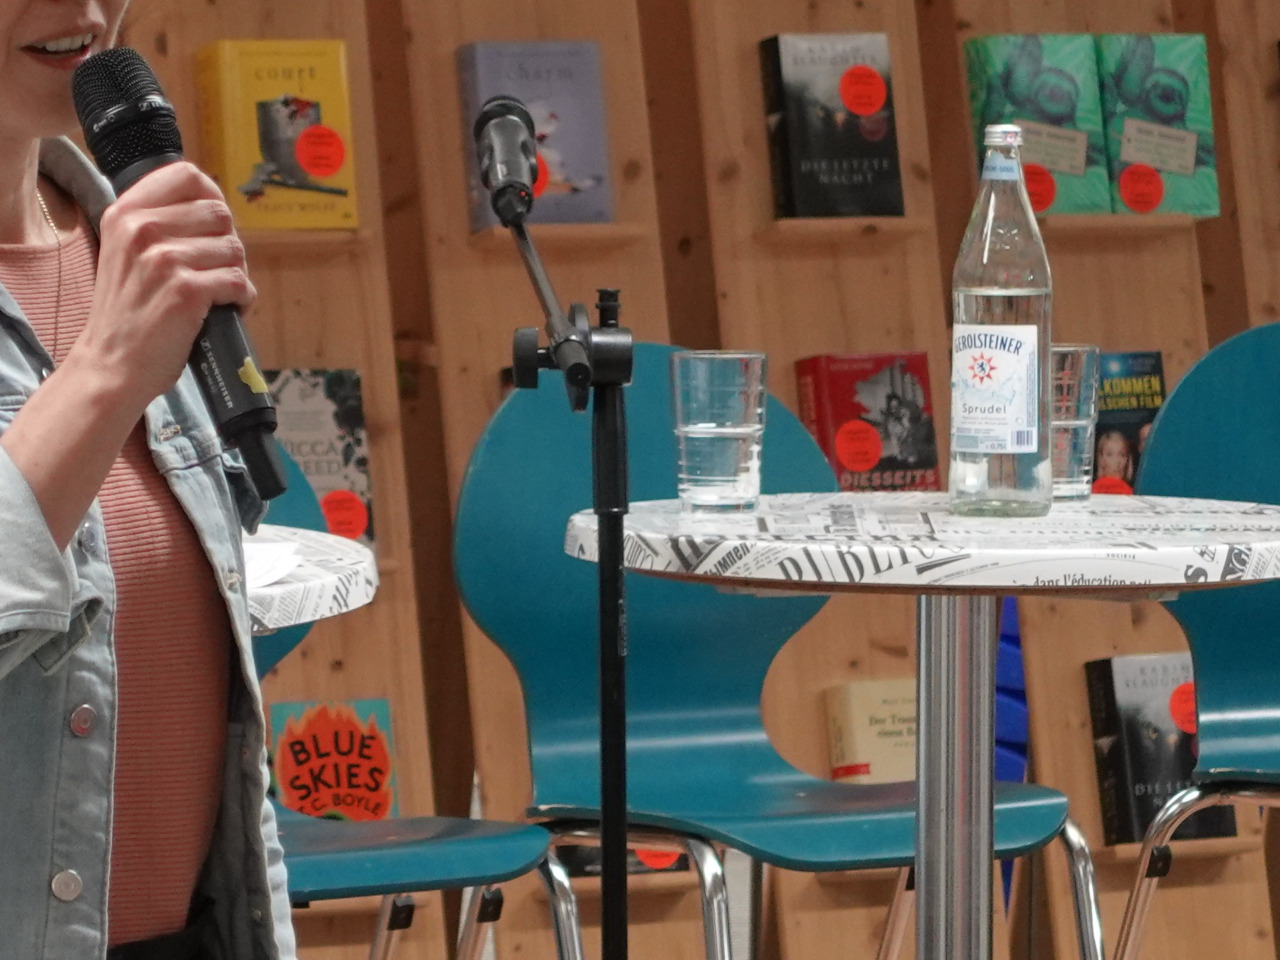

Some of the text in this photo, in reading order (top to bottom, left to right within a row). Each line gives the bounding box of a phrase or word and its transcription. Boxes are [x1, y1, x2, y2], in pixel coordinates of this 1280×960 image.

[954, 332, 1023, 356] GEROLSTEINER
[962, 403, 1007, 415] Sprudel
[288, 730, 376, 767] BLUE
[288, 762, 385, 801] SKIES
[332, 793, 382, 816] BOYLE
